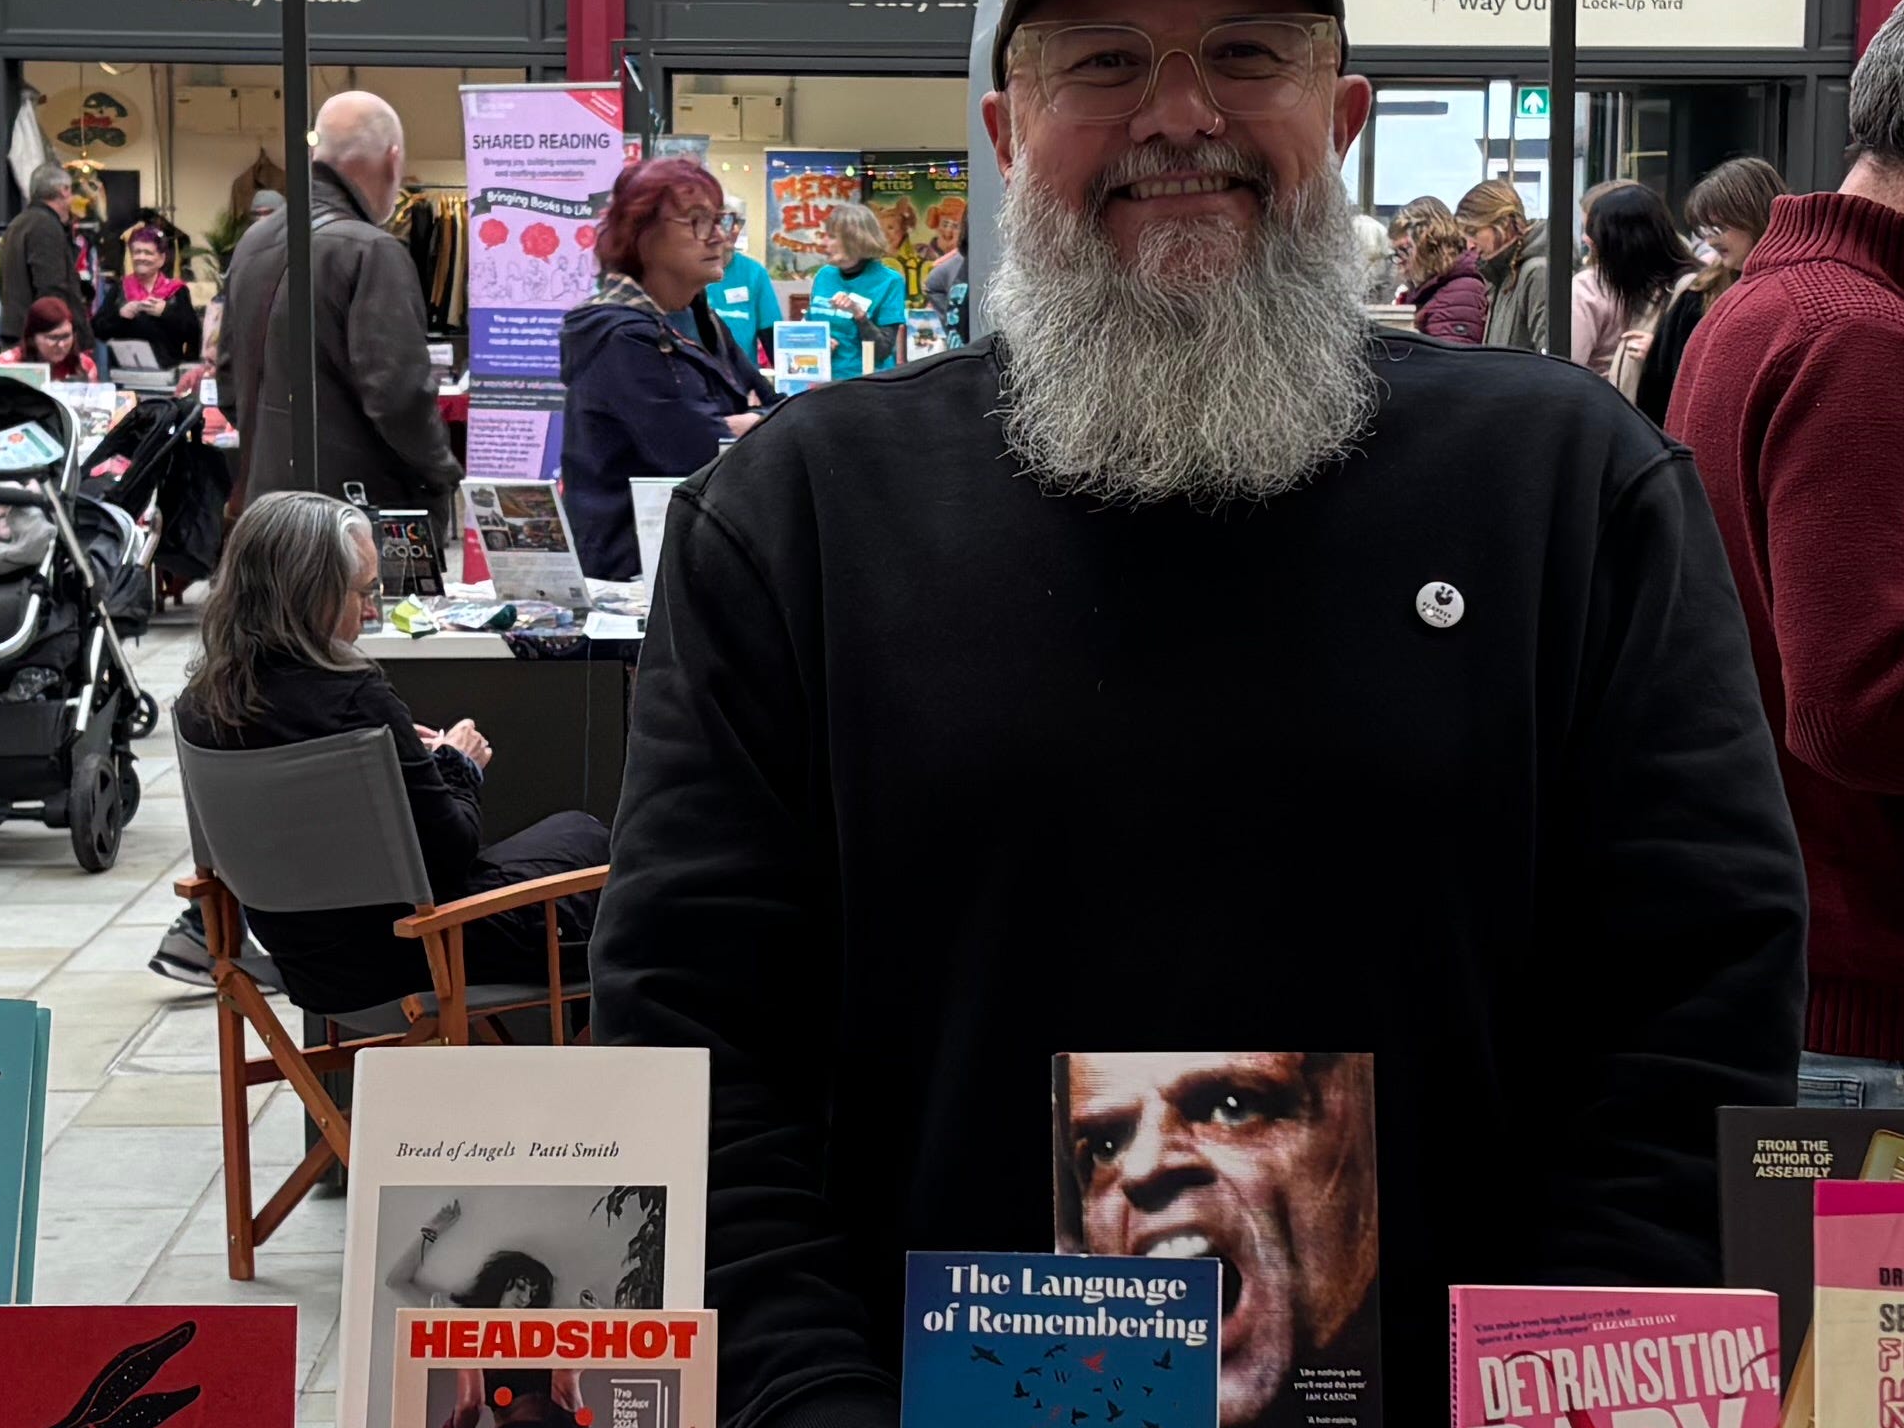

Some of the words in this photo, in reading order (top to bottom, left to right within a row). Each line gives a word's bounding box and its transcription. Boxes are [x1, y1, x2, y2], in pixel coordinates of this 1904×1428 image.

[472, 134, 535, 150] SHARED
[539, 132, 611, 149] READING
[487, 189, 528, 208] Bringing
[530, 194, 561, 213] Books
[574, 203, 593, 216] Life
[396, 1141, 442, 1159] Bread
[446, 1141, 465, 1162] of
[466, 1141, 516, 1160] Angels
[528, 1140, 567, 1158] Patti
[572, 1140, 620, 1158] Smith
[1757, 1139, 1796, 1153] FROM
[1802, 1140, 1829, 1153] THE
[1753, 1152, 1805, 1165] AUTHOR
[1813, 1153, 1833, 1165] OF
[1755, 1165, 1831, 1179] ASSEMBLY
[946, 1265, 1010, 1295] The
[1022, 1267, 1187, 1303] Language
[923, 1303, 958, 1332] of
[969, 1306, 1207, 1345] Remembering
[409, 1320, 698, 1359] HEADSHOT
[1479, 1325, 1779, 1419] DETRANSITION,
